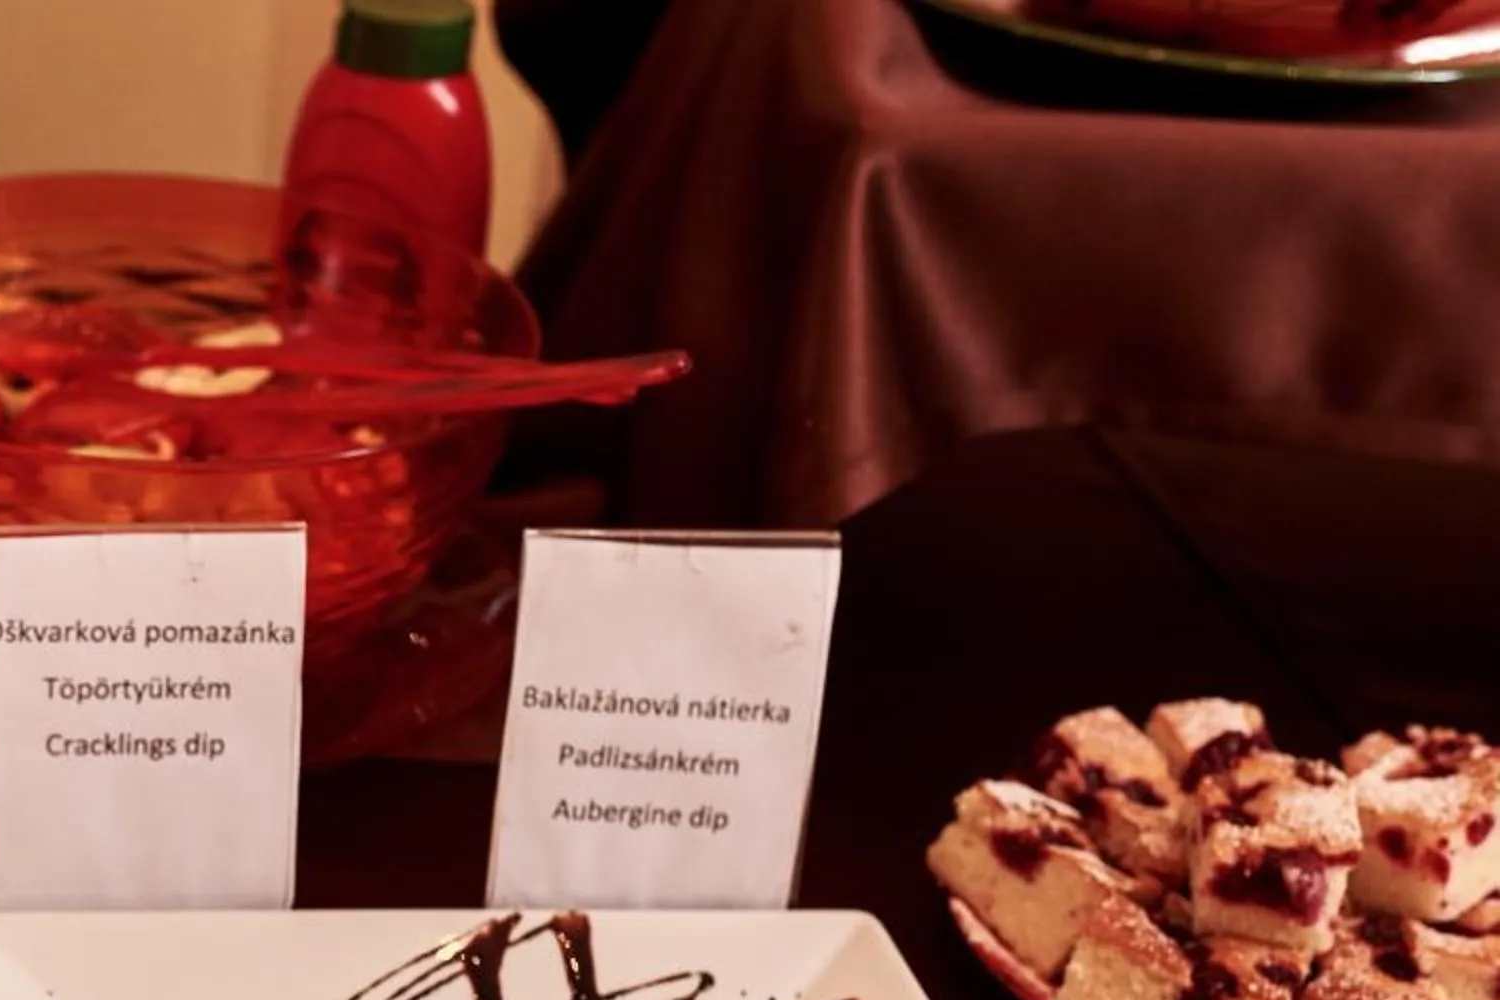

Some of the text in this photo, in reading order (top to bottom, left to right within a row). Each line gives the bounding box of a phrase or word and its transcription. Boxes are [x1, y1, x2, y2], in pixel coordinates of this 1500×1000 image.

[145, 620, 296, 648] pomazánka
[43, 676, 232, 704] Töpörtyükrém
[522, 685, 791, 724] Baklažánová nátierka
[45, 732, 226, 761] Cracklings dip
[558, 744, 740, 777] Padlizsánkrém
[551, 798, 730, 833] Aubergine dip
